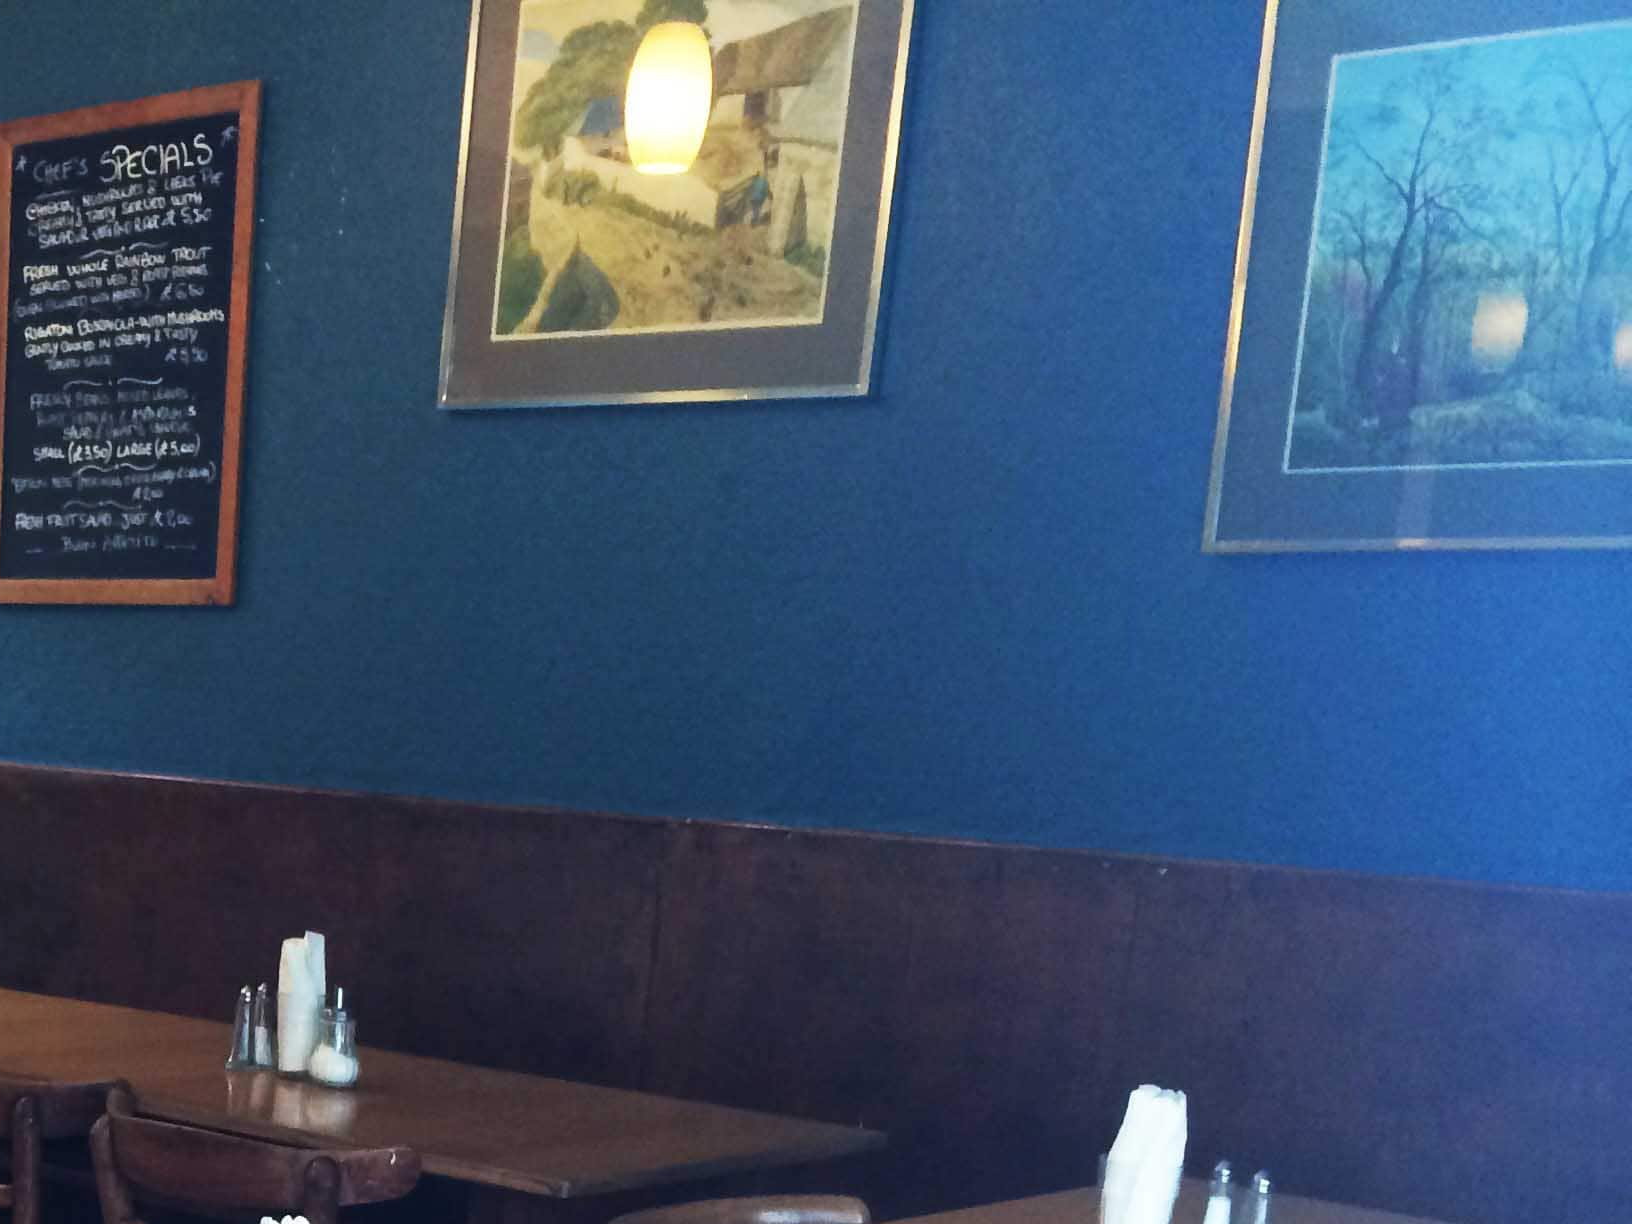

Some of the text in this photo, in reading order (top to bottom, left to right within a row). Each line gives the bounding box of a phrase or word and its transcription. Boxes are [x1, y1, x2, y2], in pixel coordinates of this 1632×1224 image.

[33, 133, 213, 183] CHEF'S SPECIALS
[23, 246, 213, 284] FRESH WHOLE RAINBOW TROUT
[99, 335, 111, 349] IN
[117, 441, 153, 459] LARGE
